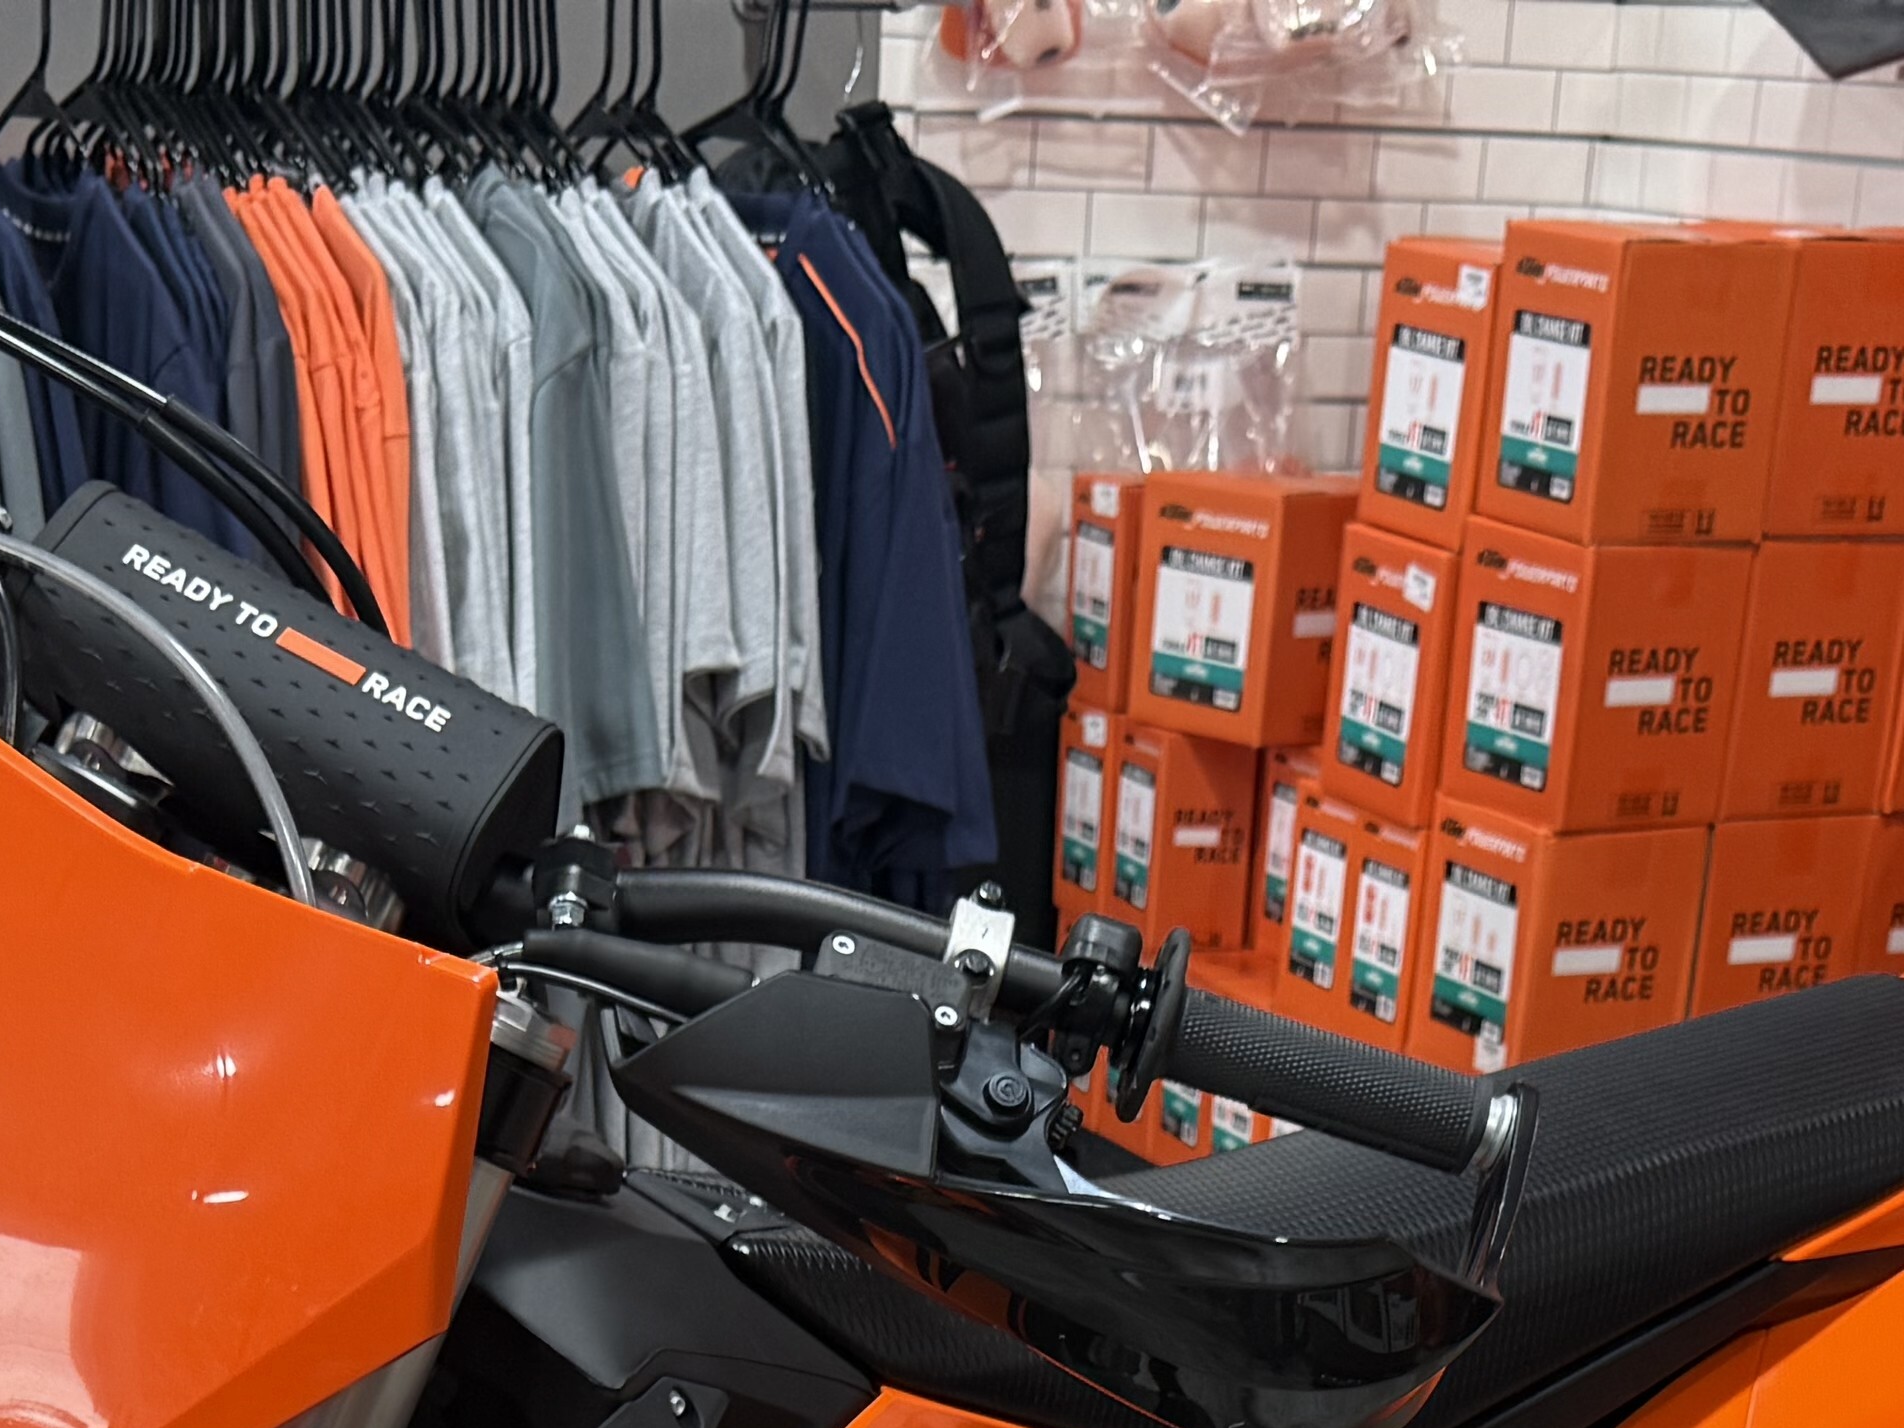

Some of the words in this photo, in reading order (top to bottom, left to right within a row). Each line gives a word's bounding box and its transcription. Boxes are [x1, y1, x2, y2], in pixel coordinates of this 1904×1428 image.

[1639, 355, 1737, 384] READY
[1715, 388, 1751, 416] TO
[1669, 421, 1747, 449] RACE
[122, 543, 234, 612] READY
[234, 600, 280, 639] TO
[362, 672, 452, 733] RACE
[1608, 647, 1699, 675] READY
[1773, 639, 1863, 667] READY
[1680, 677, 1712, 703] TO
[1843, 668, 1876, 694] TO
[1637, 707, 1708, 736] RACE
[1800, 699, 1870, 725] RACE
[1556, 917, 1646, 945] READY
[1731, 910, 1820, 936] READY
[1627, 946, 1660, 971] TO
[1799, 937, 1832, 962] TO
[1584, 976, 1653, 1003] RACE
[1758, 965, 1827, 992] RACE
